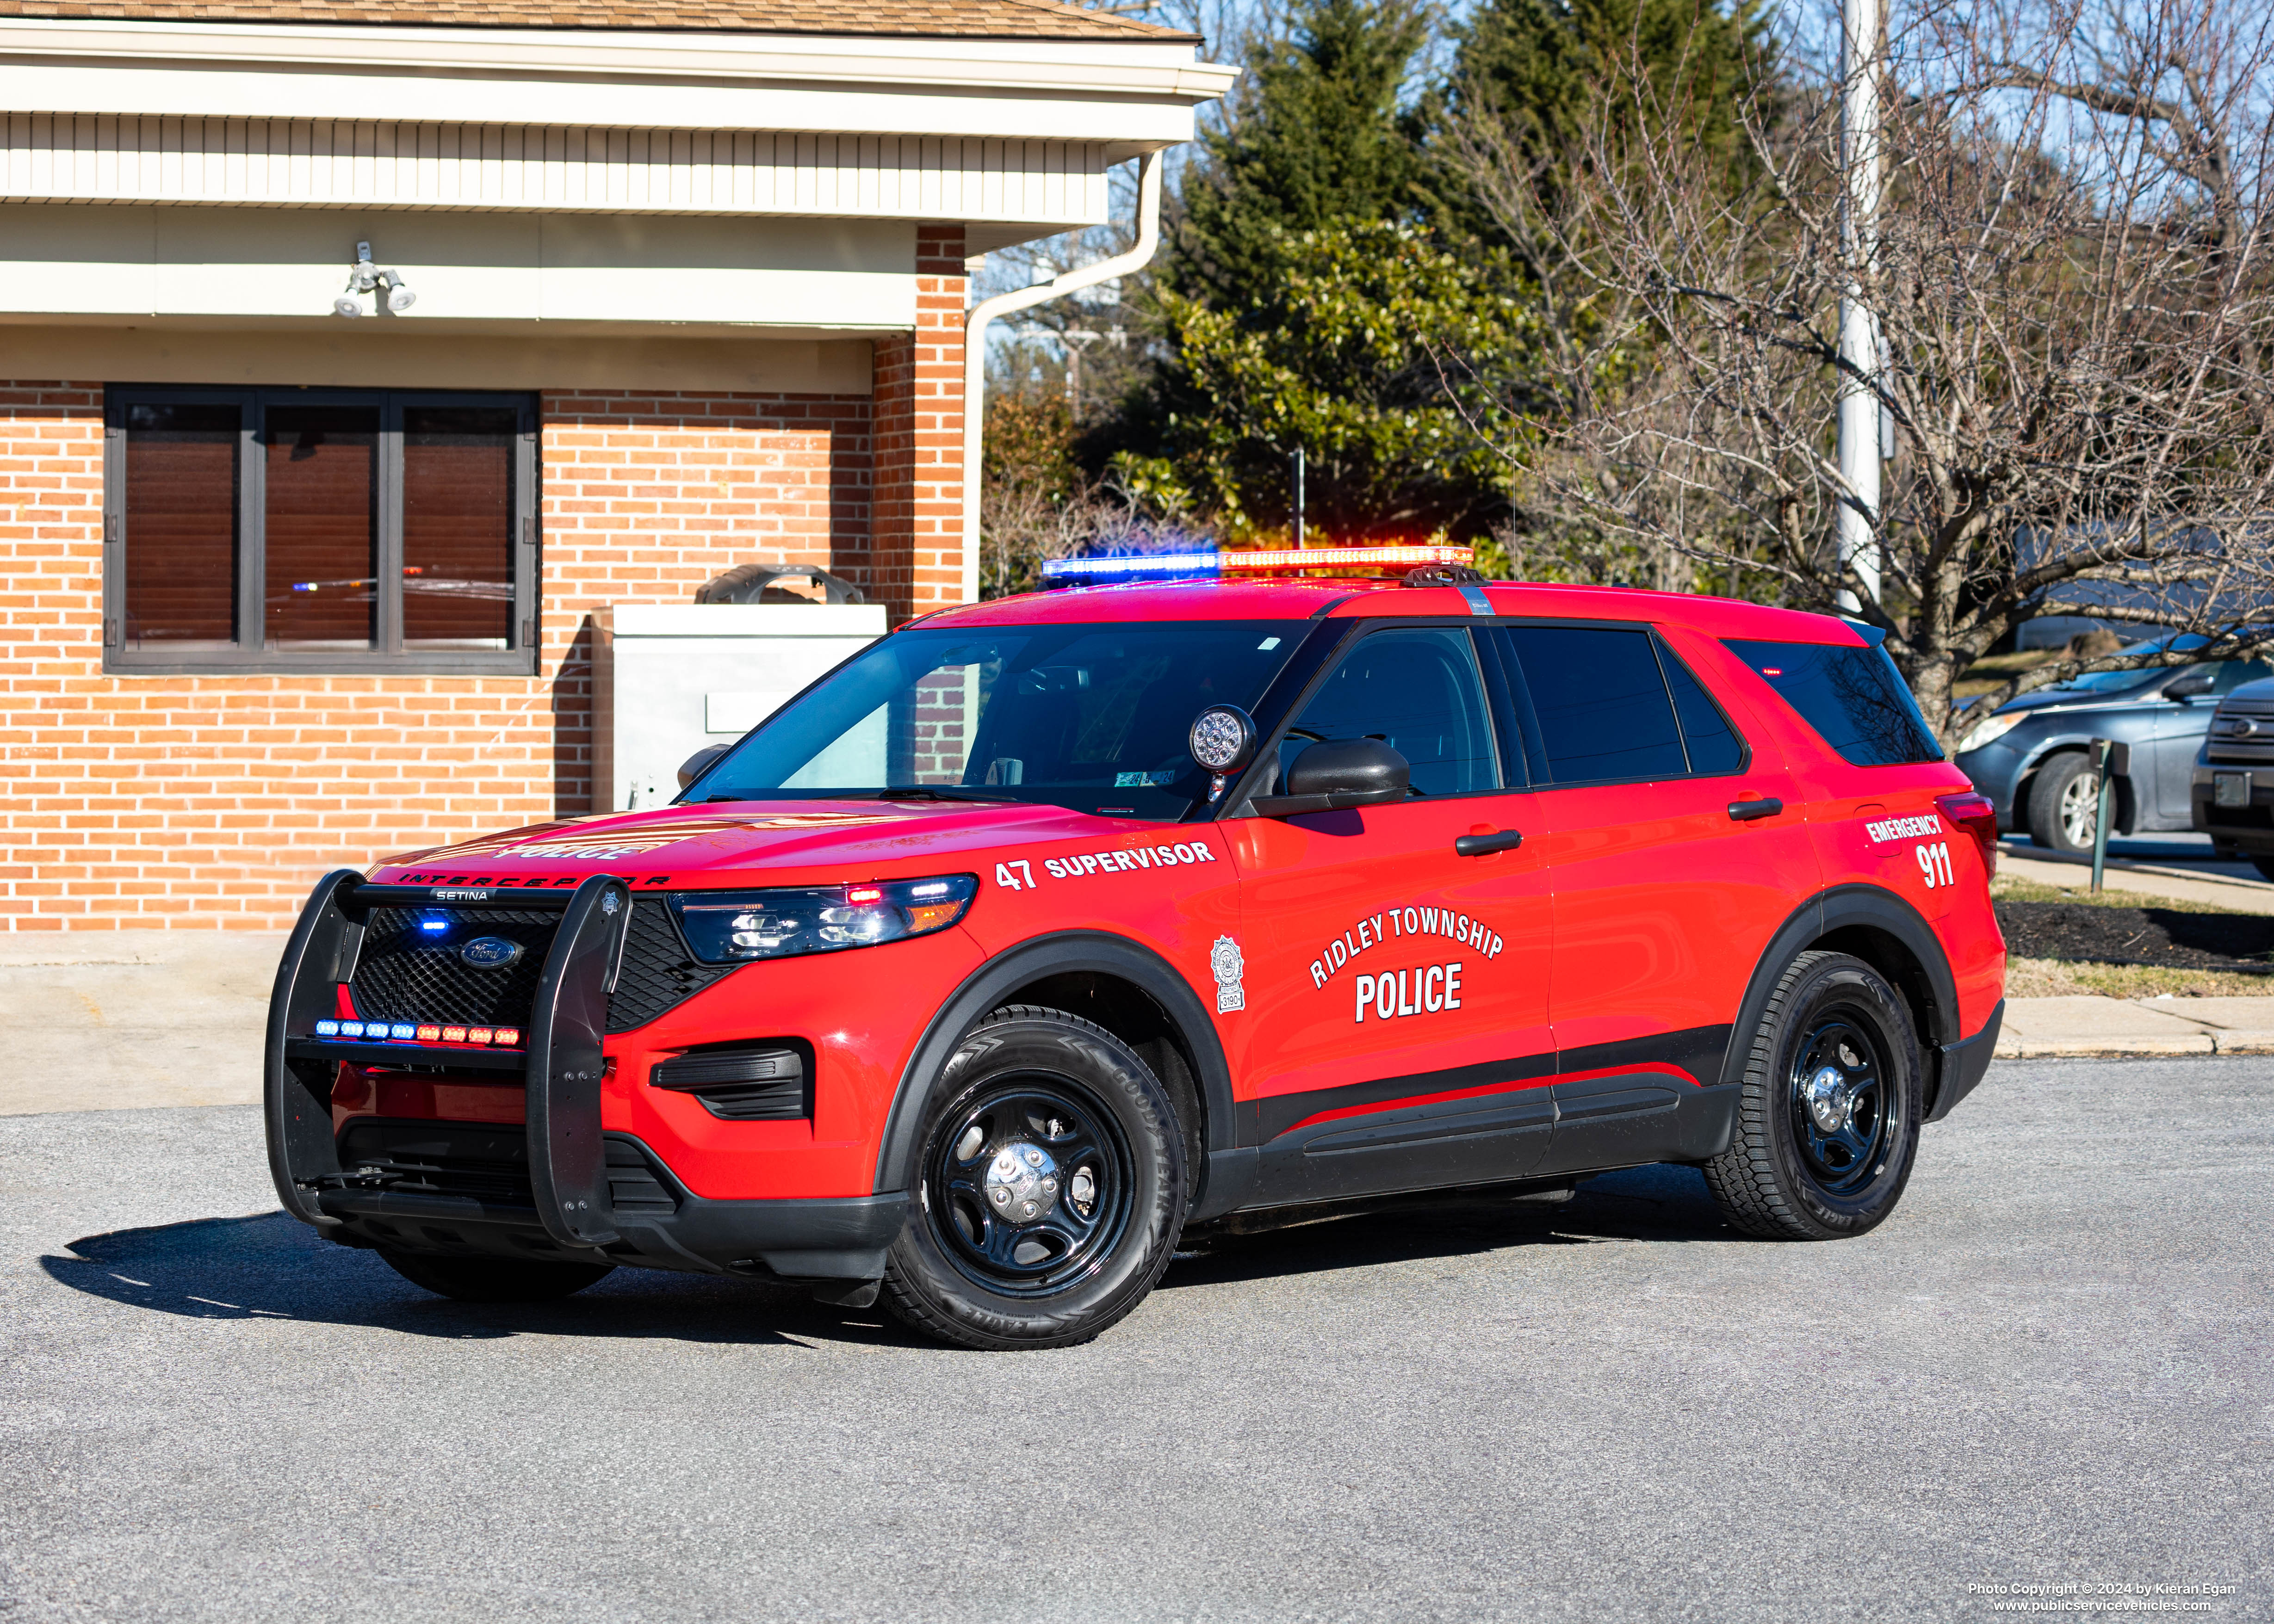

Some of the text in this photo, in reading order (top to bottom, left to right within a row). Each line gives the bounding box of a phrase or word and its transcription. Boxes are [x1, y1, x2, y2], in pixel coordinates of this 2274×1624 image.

[1866, 814, 1943, 843] EMERGENCY
[492, 845, 647, 860] POLICE
[996, 841, 1216, 891] 47 SUPERVISOR
[1916, 841, 1955, 889] 911
[398, 873, 671, 887] INTERCEPR
[437, 891, 488, 901] SETINA
[469, 943, 504, 960] Ford
[1309, 906, 1504, 990] RIDLEY TOWNSHIP
[1223, 995, 1238, 1007] 3190
[1355, 962, 1462, 1023] POLICE
[1112, 1068, 1171, 1213] GOODYEAR
[961, 1309, 1029, 1334] EAGLE
